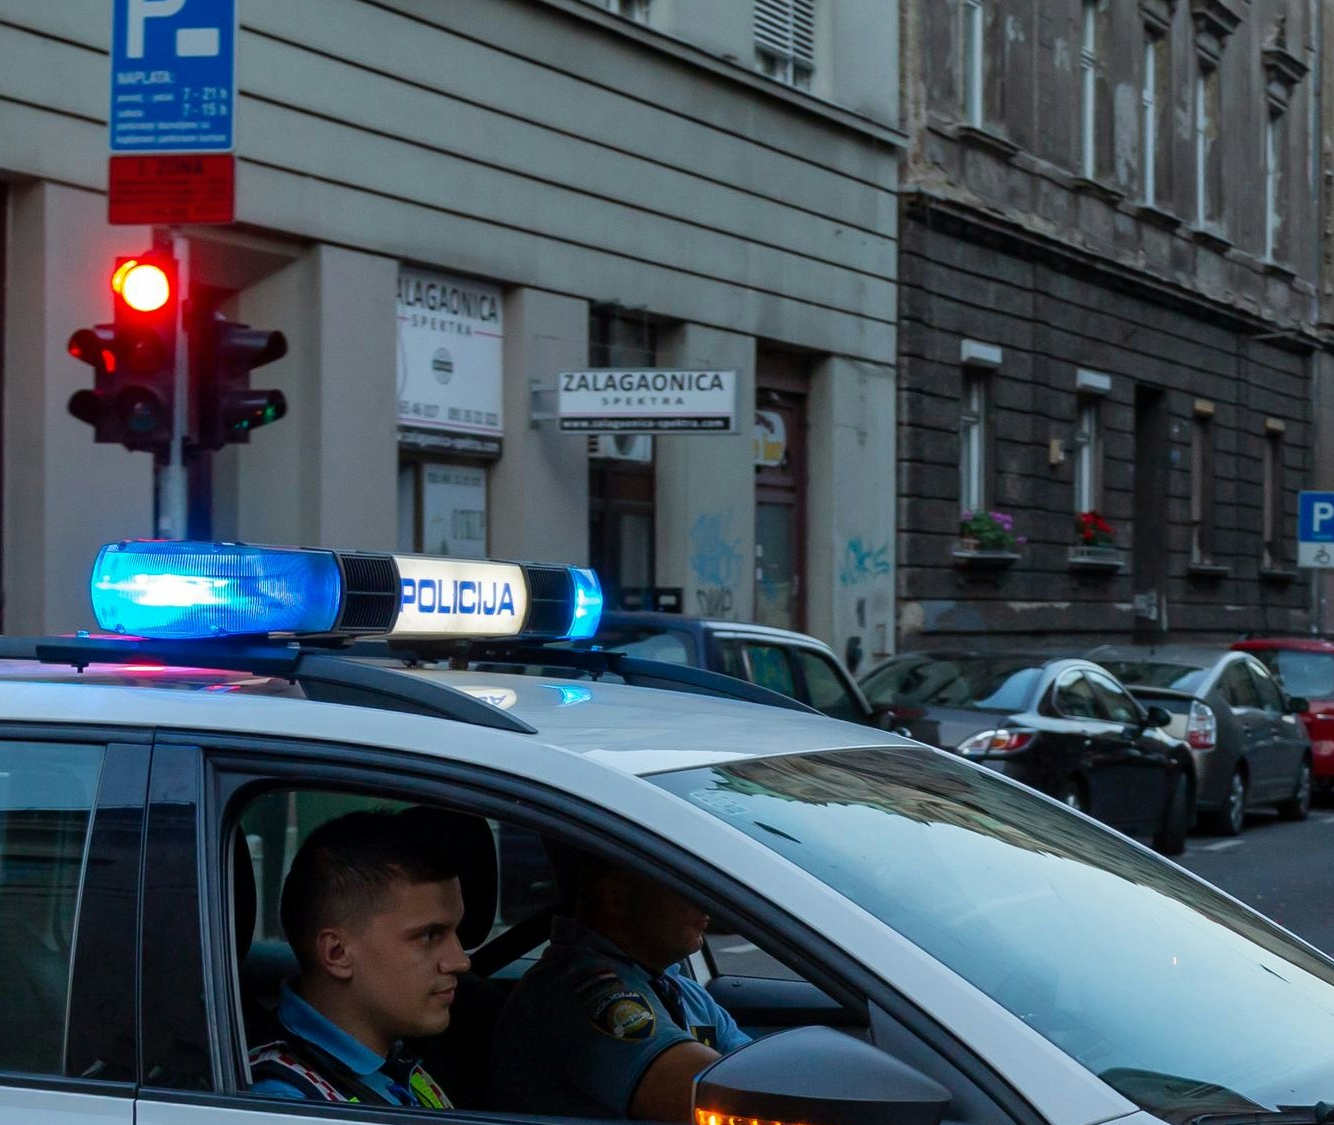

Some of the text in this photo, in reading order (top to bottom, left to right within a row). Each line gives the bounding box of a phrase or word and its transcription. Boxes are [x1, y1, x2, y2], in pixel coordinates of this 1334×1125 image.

[127, 0, 186, 58] P
[397, 277, 499, 324] ALAGAONICA
[411, 313, 472, 337] SPEKTRA
[563, 373, 724, 392] ZALAGAONICA
[601, 396, 686, 406] SPEKTRA
[1313, 502, 1334, 532] P
[399, 577, 515, 616] POLICIJA
